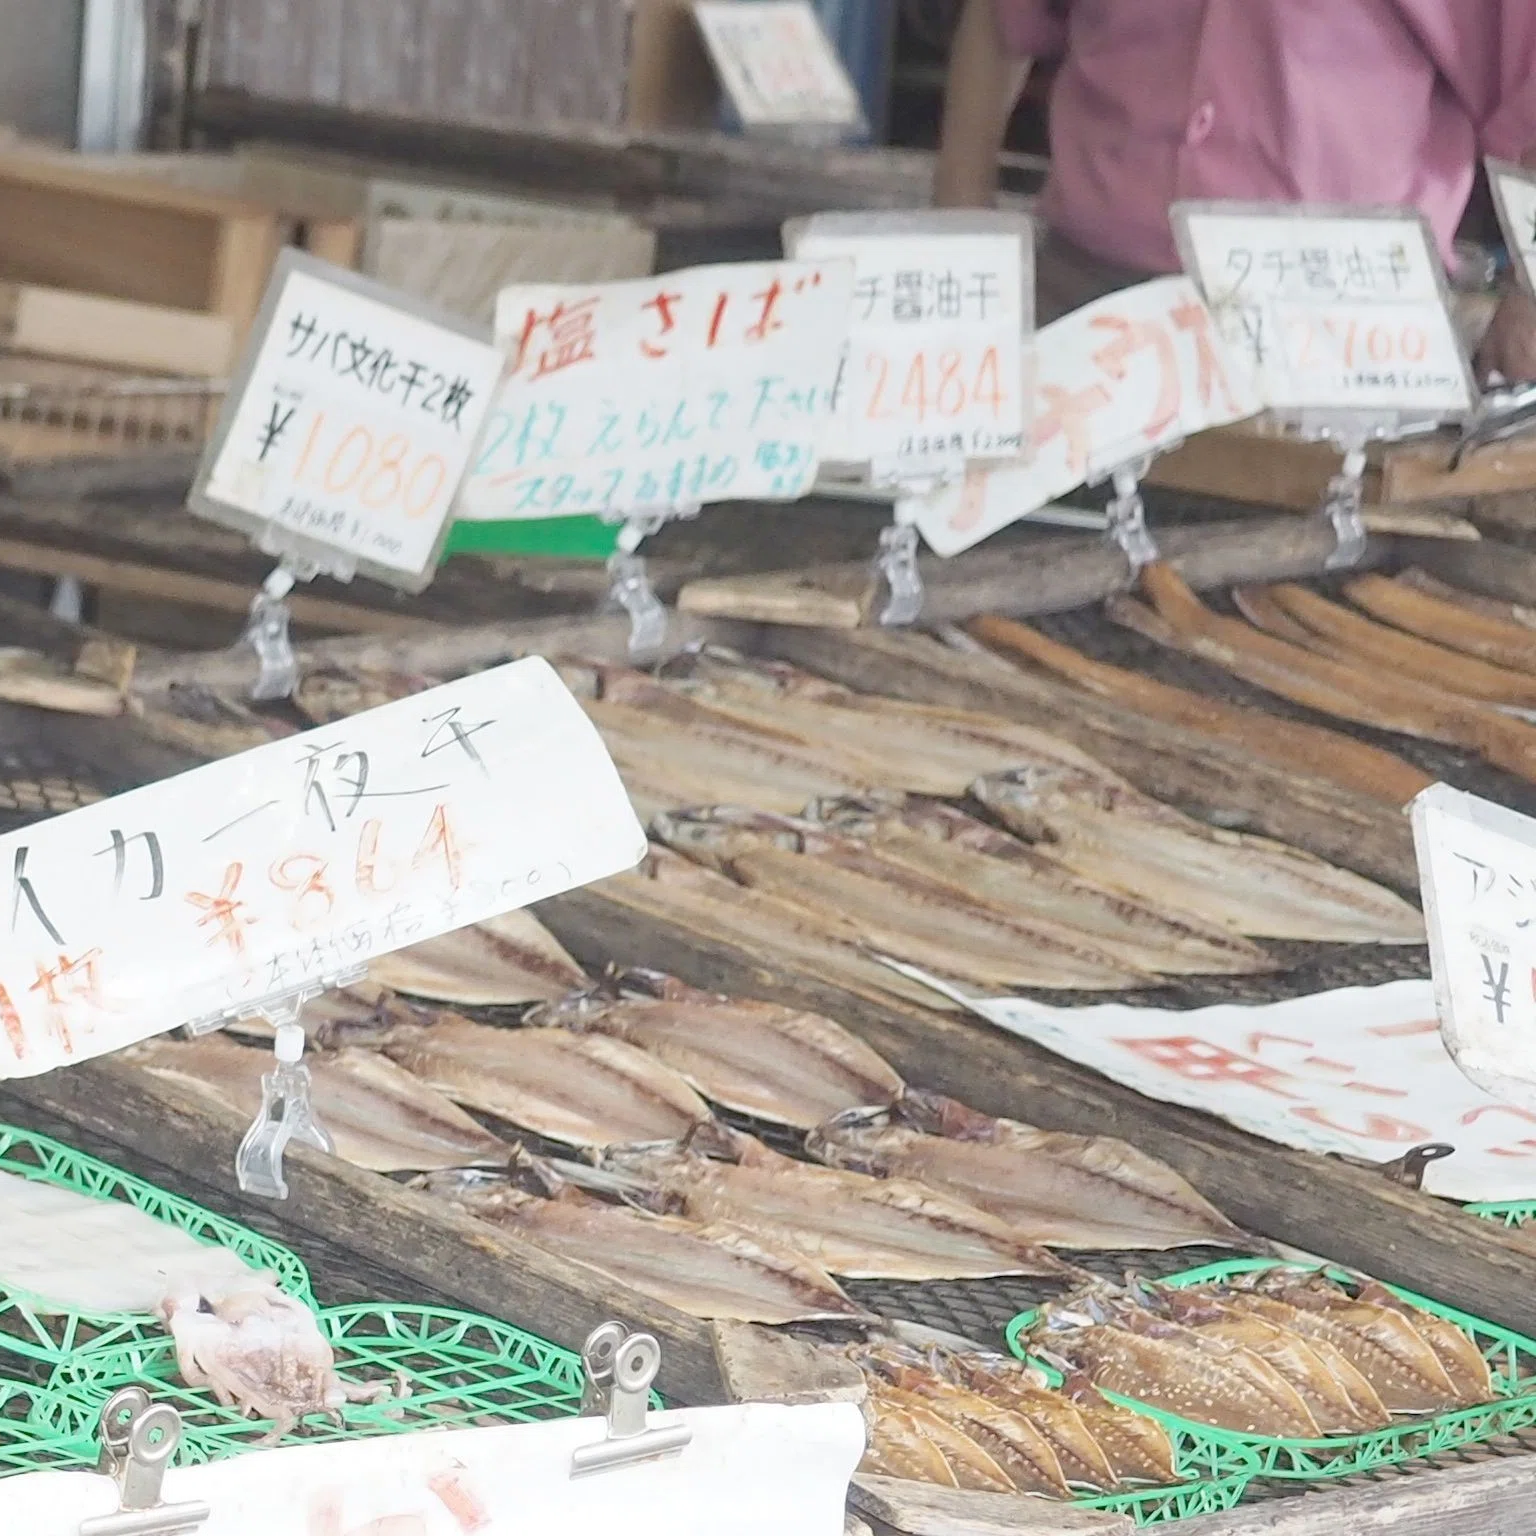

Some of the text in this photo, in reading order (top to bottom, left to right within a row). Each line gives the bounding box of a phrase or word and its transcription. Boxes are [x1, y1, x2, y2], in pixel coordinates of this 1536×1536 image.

[508, 271, 823, 380] 塩さば
[853, 269, 1001, 323] チ醤油干
